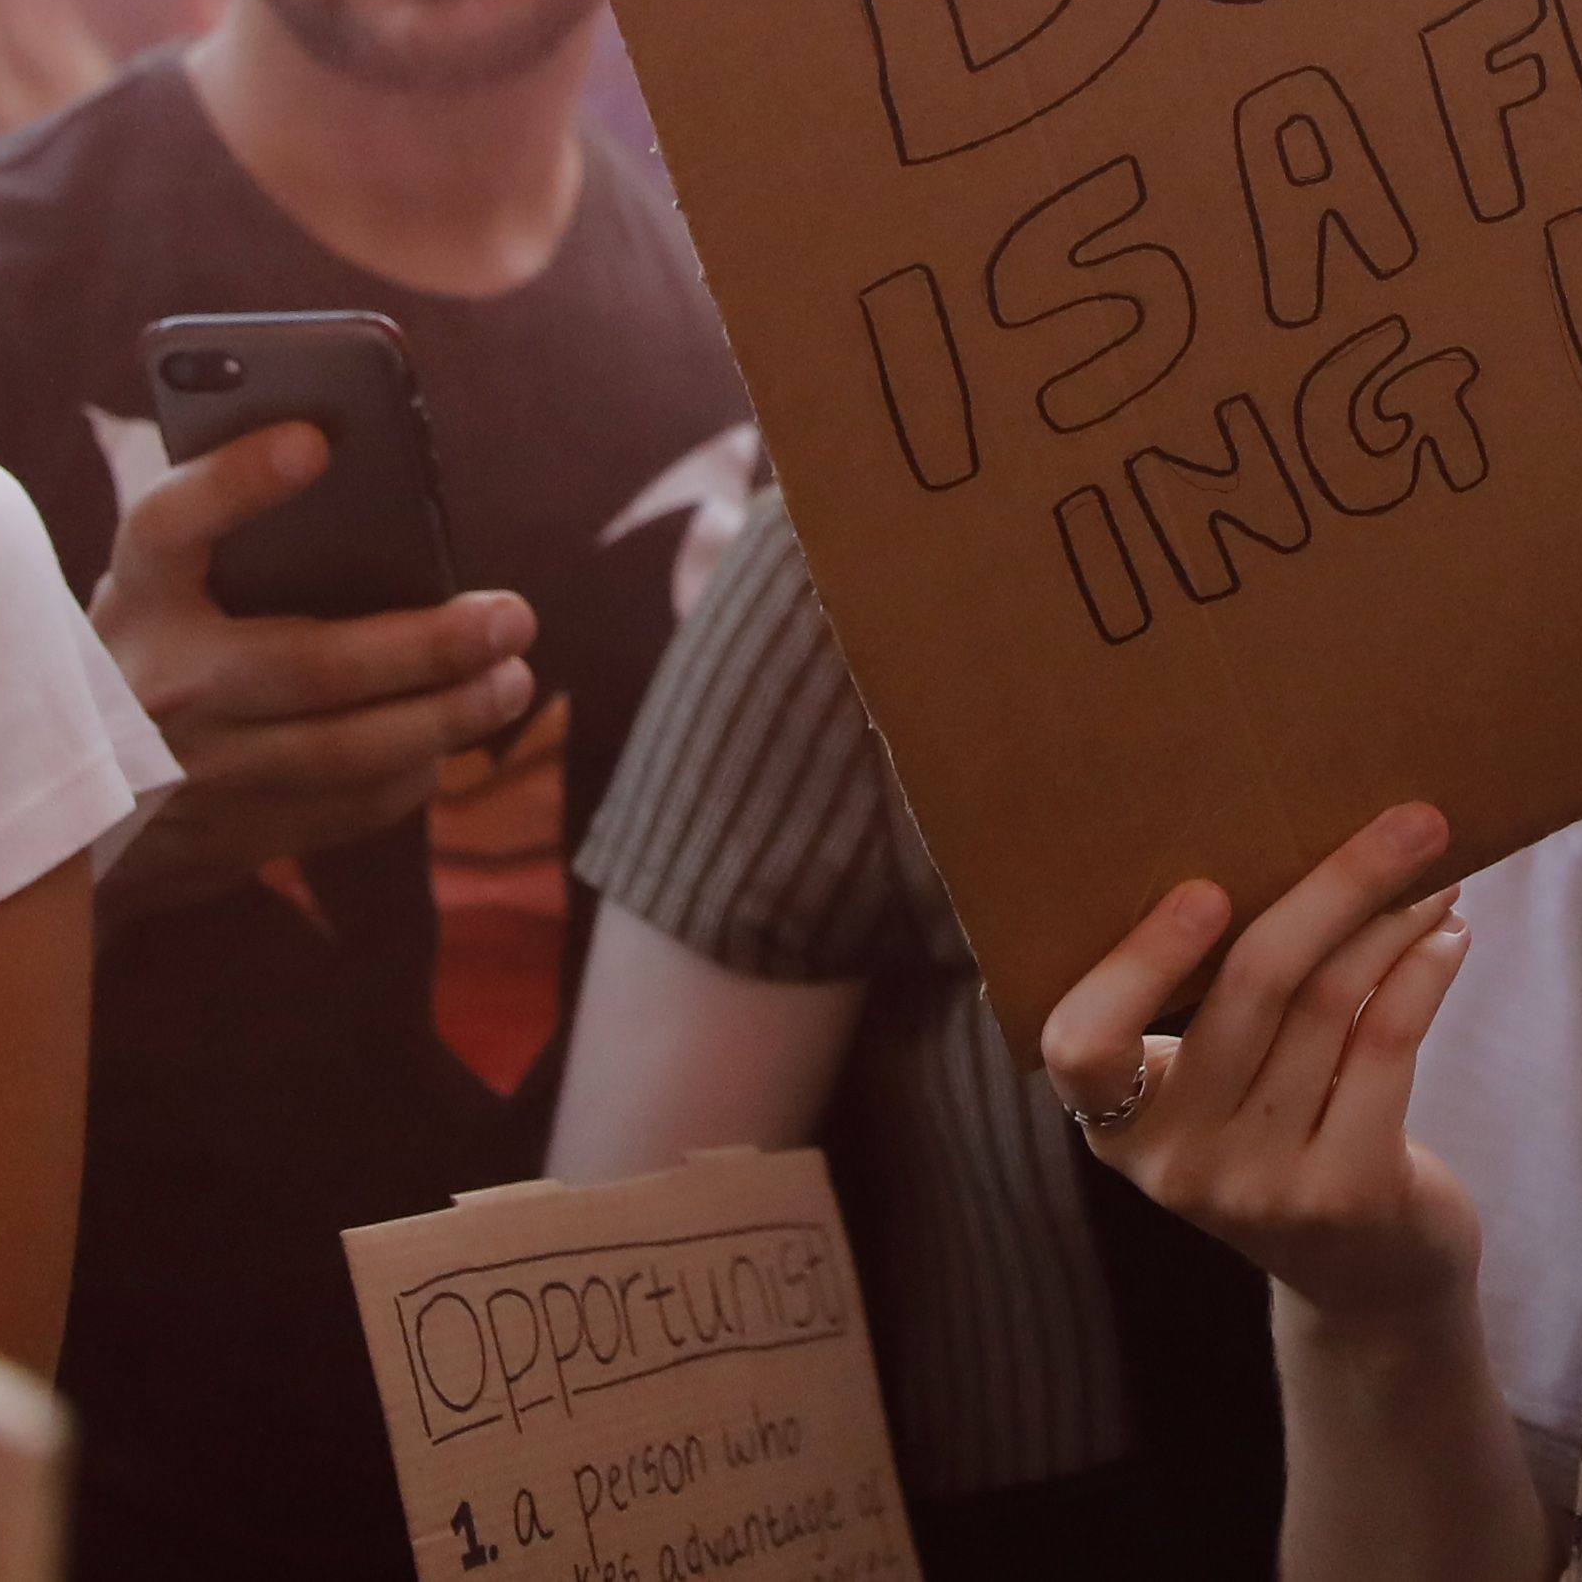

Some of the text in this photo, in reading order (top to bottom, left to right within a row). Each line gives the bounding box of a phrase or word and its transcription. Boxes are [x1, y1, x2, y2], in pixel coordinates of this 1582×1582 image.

[858, 154, 1197, 492] IS
[1233, 66, 1418, 328] A
[1053, 314, 1490, 646] ING
[450, 1401, 803, 1573] 1. a person who
[659, 1487, 848, 1582] advantage
